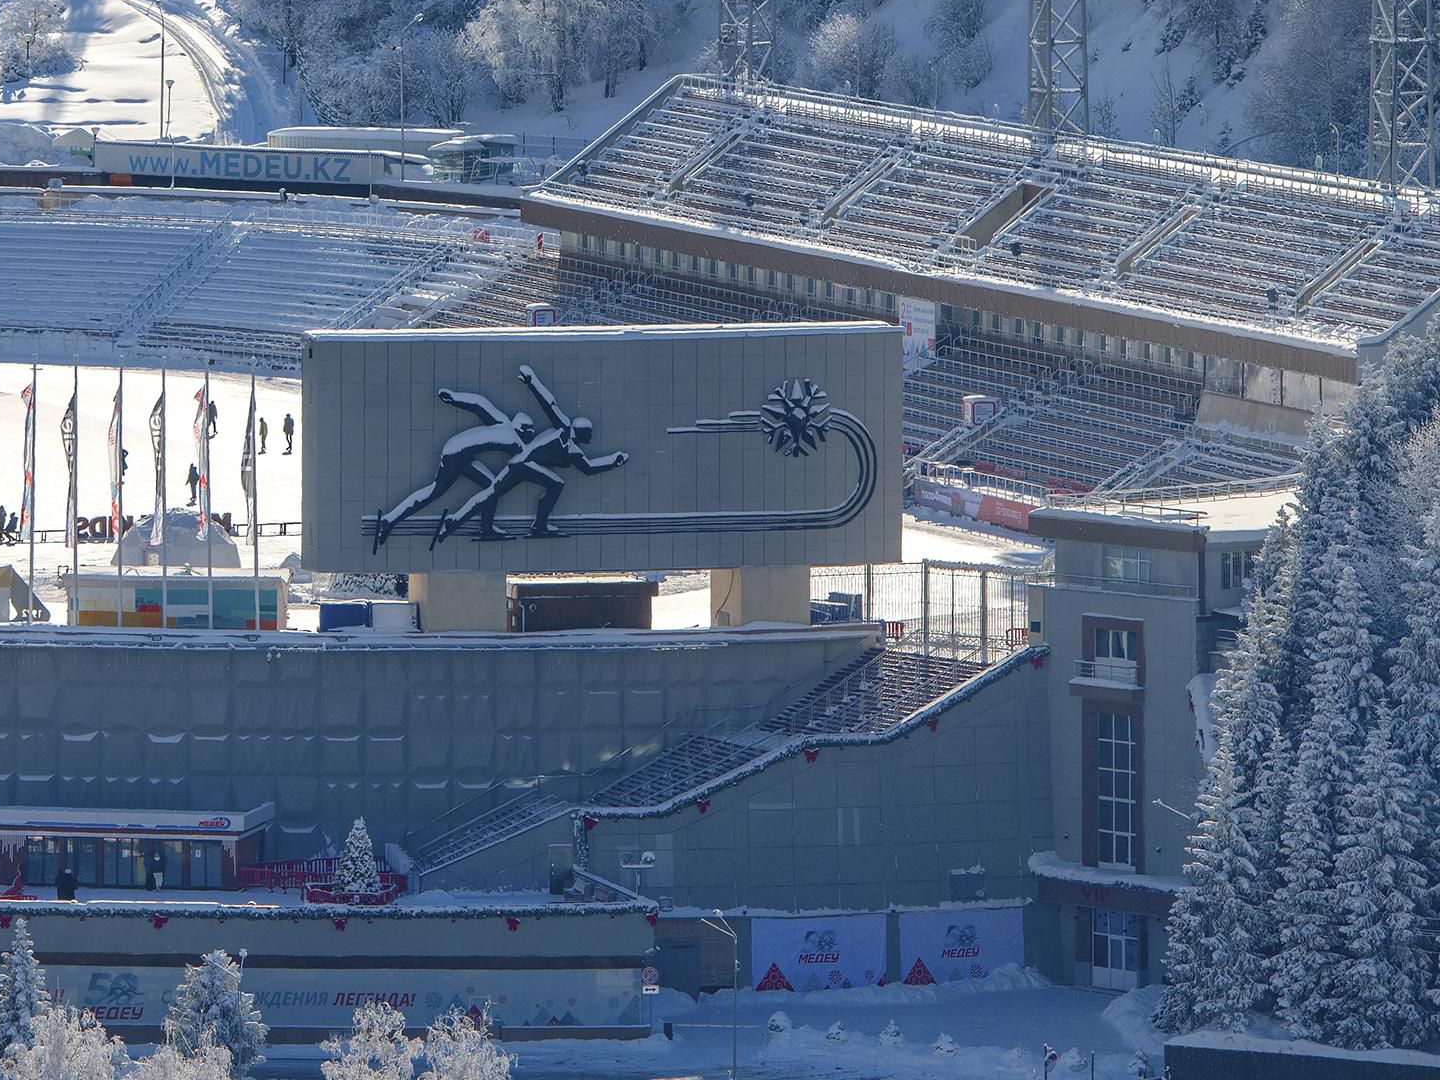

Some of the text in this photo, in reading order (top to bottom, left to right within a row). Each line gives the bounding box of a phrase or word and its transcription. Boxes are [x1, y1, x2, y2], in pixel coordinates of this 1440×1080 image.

[1082, 887, 1110, 902] VIP
[798, 953, 840, 963] МЕДЕУ
[941, 948, 980, 958] МЕДЕУ
